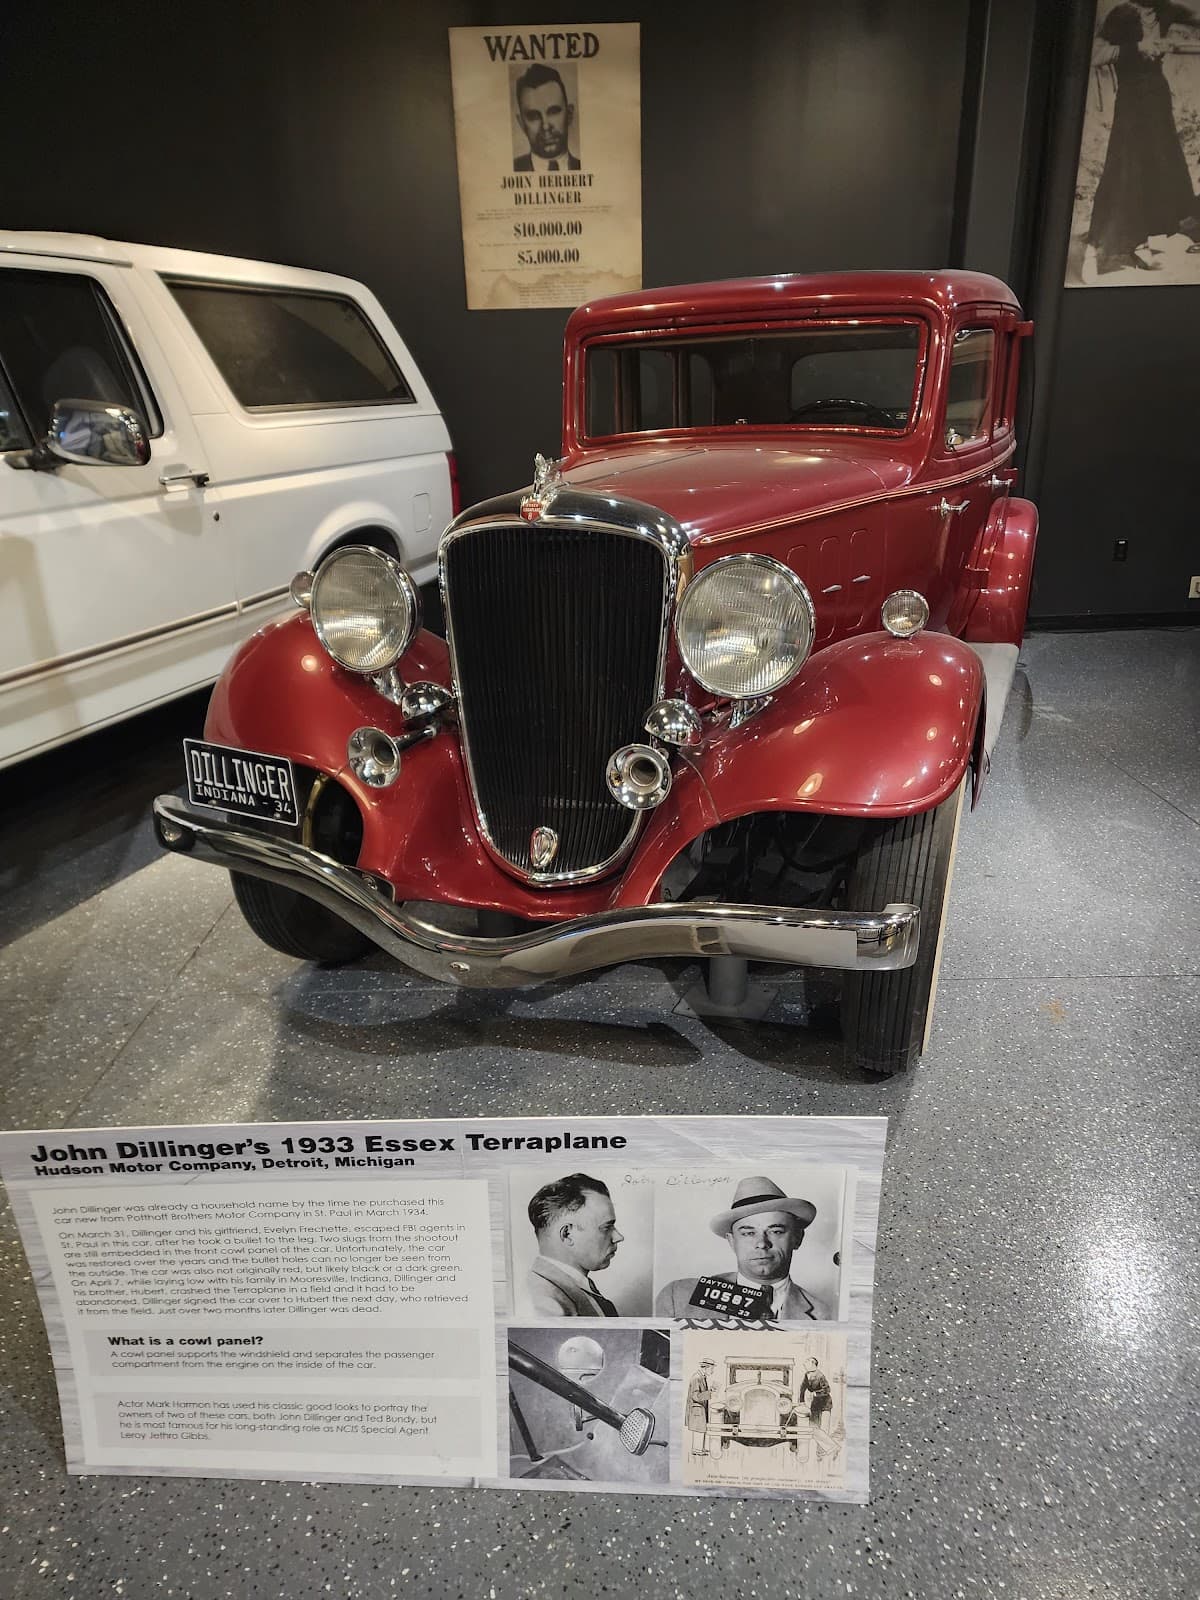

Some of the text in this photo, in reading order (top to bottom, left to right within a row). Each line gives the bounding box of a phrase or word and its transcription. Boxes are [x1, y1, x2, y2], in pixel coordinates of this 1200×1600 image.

[484, 32, 600, 62] WANTED
[500, 174, 594, 189] JOHN HERBERT
[514, 191, 582, 205] DILLINGER
[190, 750, 290, 801] DILLINGER
[195, 784, 291, 814] INDIANA 34
[30, 1132, 627, 1162] John Dillinger's 1933 Essex Terraplane
[34, 1156, 415, 1176] Hudson Motor Company, Detroit, Michigan
[52, 1206, 77, 1214] John
[80, 1204, 121, 1215] Dillinger
[148, 1202, 188, 1213] already
[201, 1201, 256, 1209] household
[291, 1200, 305, 1209] by
[369, 1198, 425, 1208] purchased
[100, 1214, 124, 1222] from
[171, 1212, 212, 1220] Brothers
[215, 1211, 245, 1219] Motor
[249, 1210, 300, 1220] Company
[58, 1231, 74, 1239] On
[77, 1230, 111, 1238] March
[131, 1228, 172, 1239] Dillinger
[264, 1226, 297, 1236] Evelyn
[354, 1224, 400, 1234] escaped
[419, 1223, 454, 1233] agents
[90, 1278, 112, 1288] April
[127, 1277, 152, 1285] while
[154, 1277, 185, 1287] laying
[246, 1275, 276, 1285] family
[350, 1274, 392, 1283] Indiana,
[394, 1274, 433, 1284] Dillinger
[700, 1278, 762, 1297] DAYTON OHIO
[108, 1336, 144, 1346] What
[150, 1336, 161, 1345] is
[179, 1336, 212, 1345] cowl
[217, 1336, 264, 1347] panel?
[146, 1350, 175, 1360] panel
[177, 1350, 218, 1360] supports
[315, 1351, 362, 1360] separates
[384, 1353, 435, 1361] passenger
[112, 1360, 180, 1370] compartment
[225, 1361, 259, 1370] engine
[172, 1401, 210, 1409] Harmon
[272, 1402, 304, 1410] classic
[306, 1403, 332, 1413] good
[373, 1404, 408, 1414] portray
[303, 1413, 341, 1424] Dillinger
[386, 1415, 418, 1425] Bundy,
[120, 1431, 146, 1441] Leroy
[168, 1422, 204, 1430] famous
[235, 1423, 300, 1433] long-standing
[336, 1425, 359, 1433] NCIS
[361, 1426, 396, 1436] Special
[398, 1427, 428, 1437] Agent
